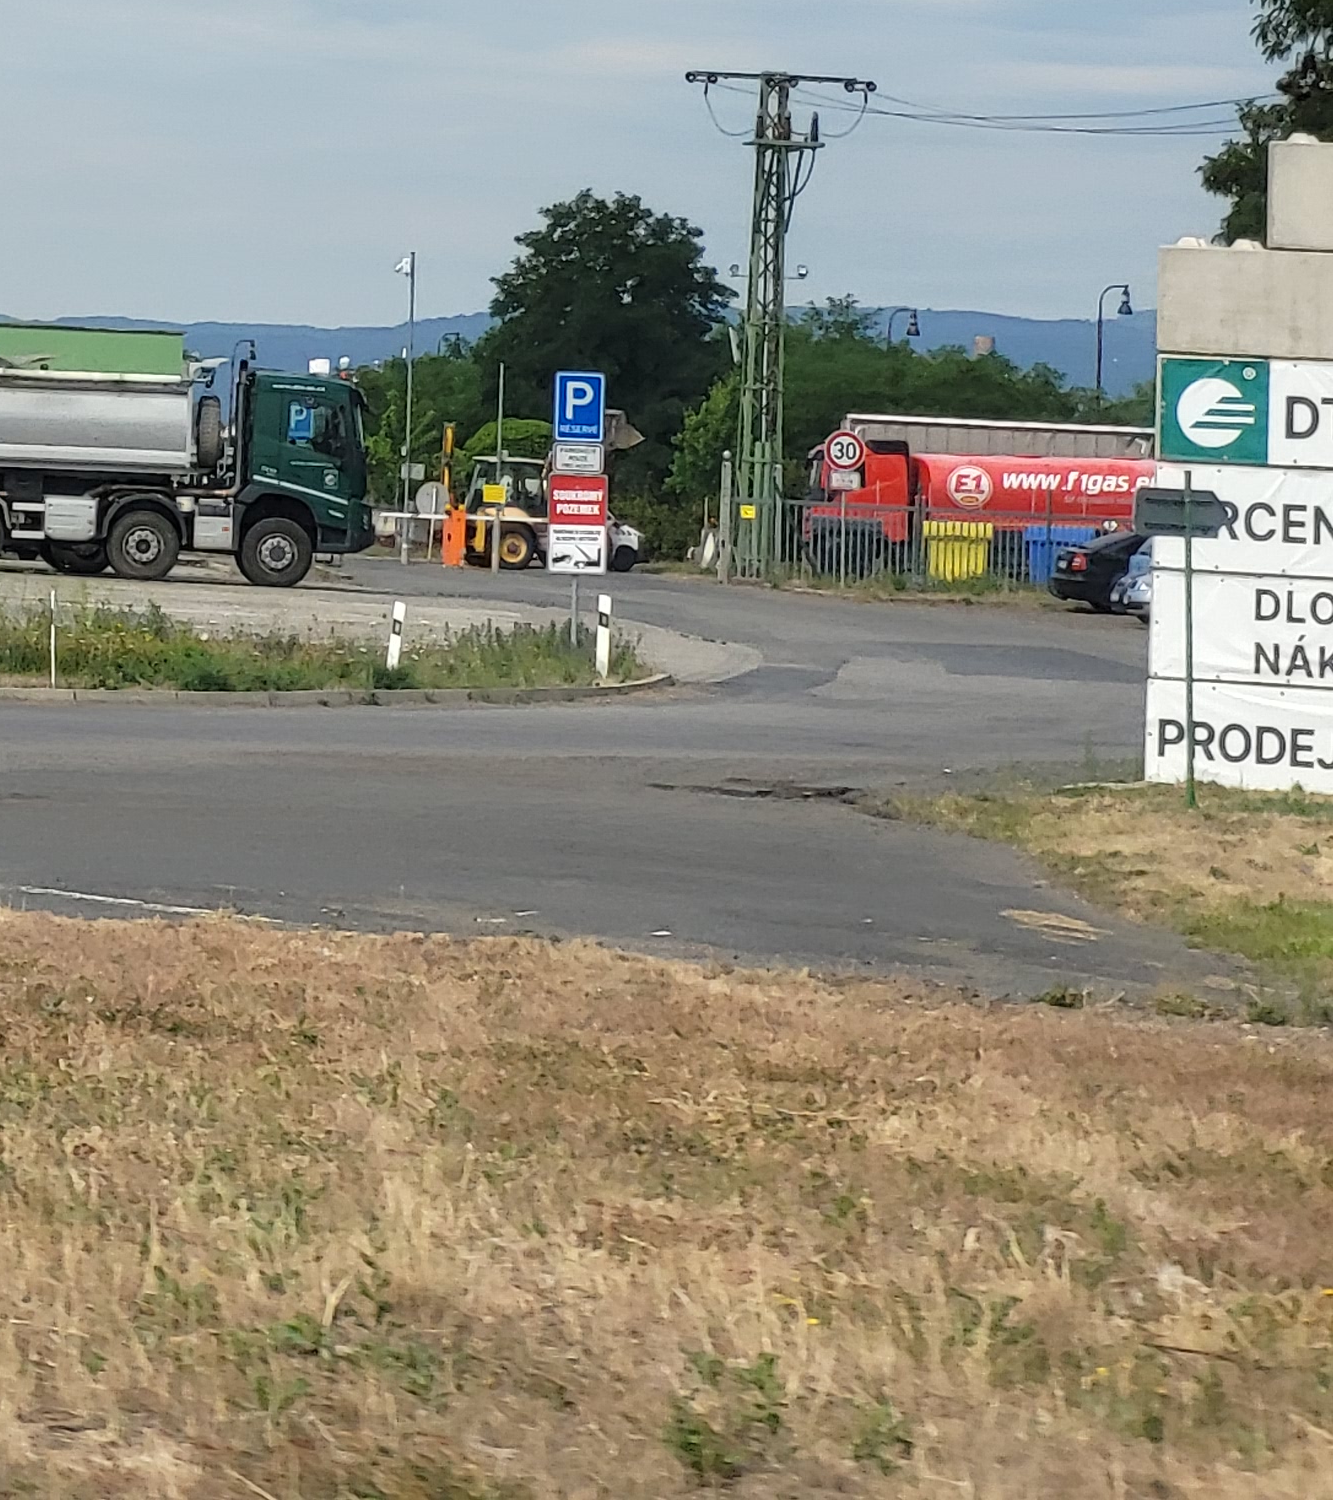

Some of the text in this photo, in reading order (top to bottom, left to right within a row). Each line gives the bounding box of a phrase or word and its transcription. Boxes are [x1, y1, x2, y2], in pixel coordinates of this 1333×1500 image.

[565, 381, 594, 420] P
[833, 441, 857, 460] 30
[1215, 500, 1333, 545] RCEN
[1254, 588, 1333, 625] DLO
